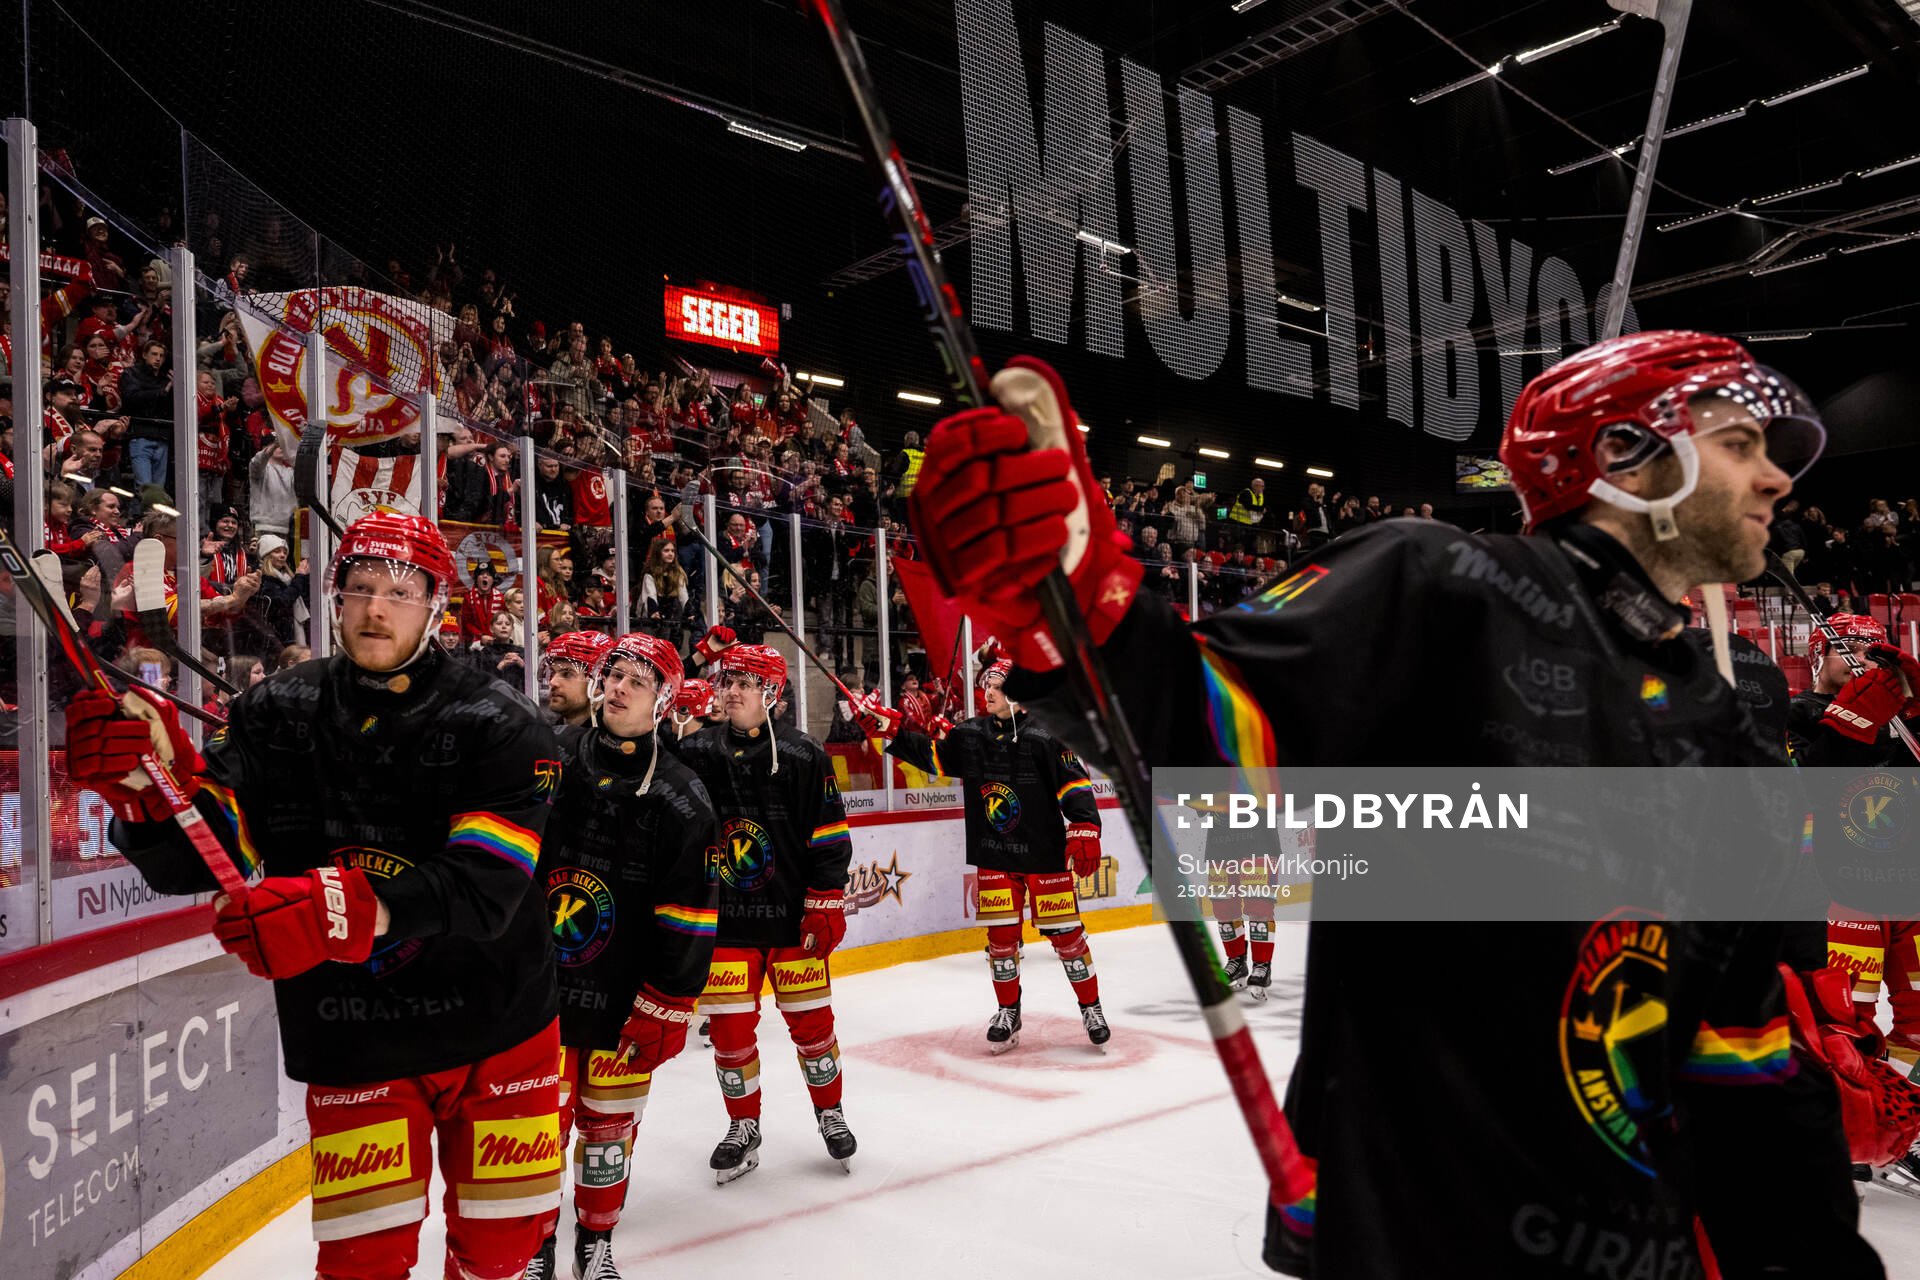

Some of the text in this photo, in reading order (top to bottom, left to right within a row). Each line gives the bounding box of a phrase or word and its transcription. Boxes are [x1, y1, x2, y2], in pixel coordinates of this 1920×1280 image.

[682, 294, 761, 346] SEGER
[368, 547, 389, 556] SPEL
[370, 541, 409, 554] SVENSKA
[1446, 540, 1576, 630] Molins
[921, 791, 957, 806] Nybloms
[843, 861, 881, 898] ars
[317, 866, 349, 941] UER
[721, 902, 787, 919] IRAFFEN
[981, 894, 1011, 908] Molins
[776, 966, 824, 985] Molins
[557, 985, 609, 1012] FFEN
[28, 1001, 240, 1181] SELECT
[505, 1074, 559, 1095] BAUER
[322, 1086, 390, 1107] BAUER
[313, 1141, 405, 1186] Molins
[585, 1145, 624, 1168] TG
[28, 1145, 140, 1248] TELECOM
